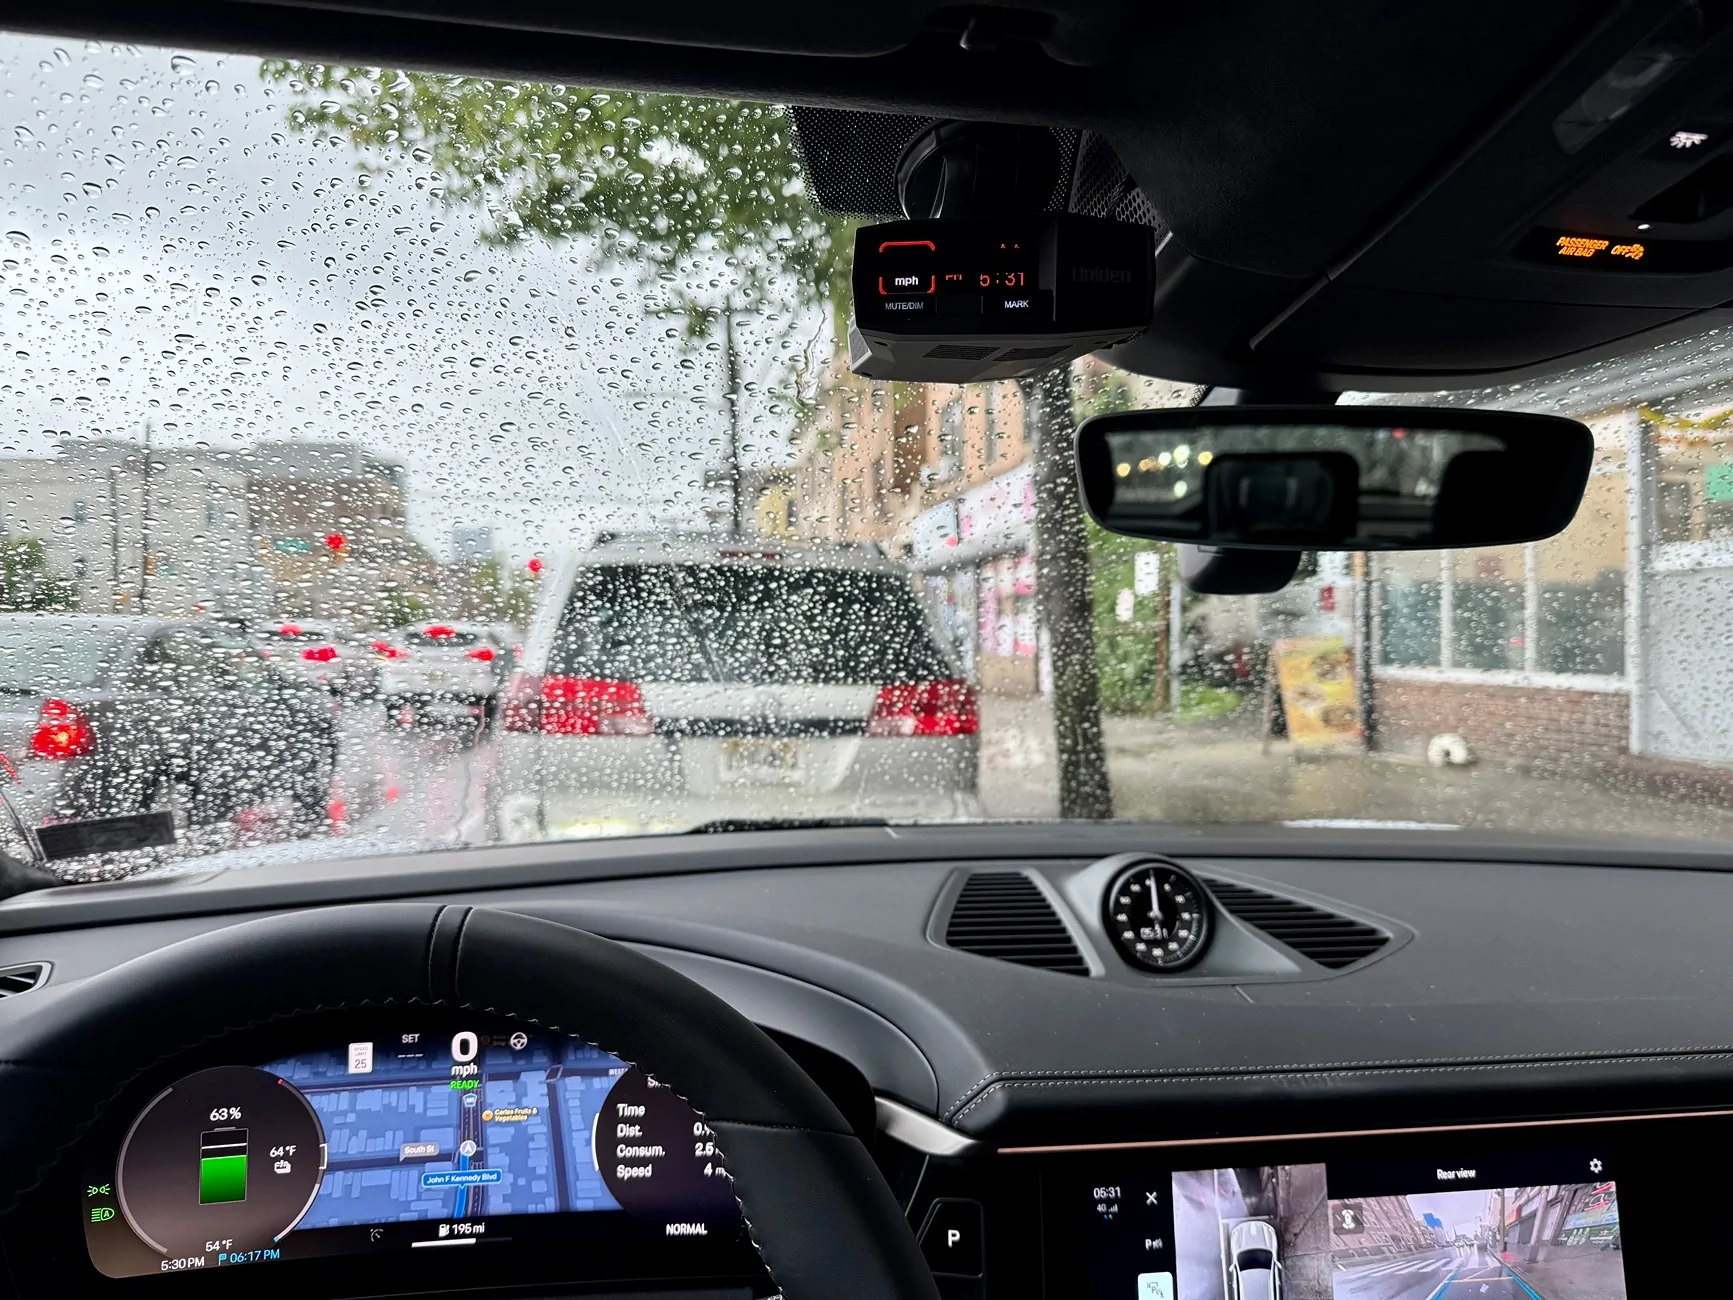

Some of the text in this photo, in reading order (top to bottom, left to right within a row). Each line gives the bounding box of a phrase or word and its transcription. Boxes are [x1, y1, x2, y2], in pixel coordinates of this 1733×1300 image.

[1556, 236, 1609, 250] PASSENGER
[1558, 246, 1595, 257] AIR BAG
[1611, 244, 1632, 256] OFF
[895, 275, 919, 287] mph
[1071, 266, 1132, 284] Uniden
[885, 302, 924, 310] MUTE/DIM
[1004, 300, 1029, 309] MARK
[402, 1033, 420, 1043] SET
[452, 1031, 478, 1062] 0
[354, 1059, 367, 1069] 25
[451, 1063, 478, 1078] mph
[451, 1079, 479, 1090] READY
[617, 1103, 646, 1118] Time
[617, 1123, 643, 1138] Dist.
[404, 1144, 435, 1154] South St
[617, 1144, 666, 1158] Consum.
[616, 1163, 653, 1181] Speed
[704, 1162, 713, 1177] 4
[1437, 1168, 1477, 1180] Rear view
[427, 1173, 498, 1184] John F Kennedy Blvd
[1093, 1186, 1121, 1200] 05:31
[1096, 1203, 1107, 1213] 4G
[472, 1222, 485, 1234] mi
[666, 1223, 708, 1236] NORMAL
[947, 1229, 961, 1248] P
[229, 1248, 280, 1263] 06:17 PM
[160, 1256, 205, 1271] 5:30 PM
